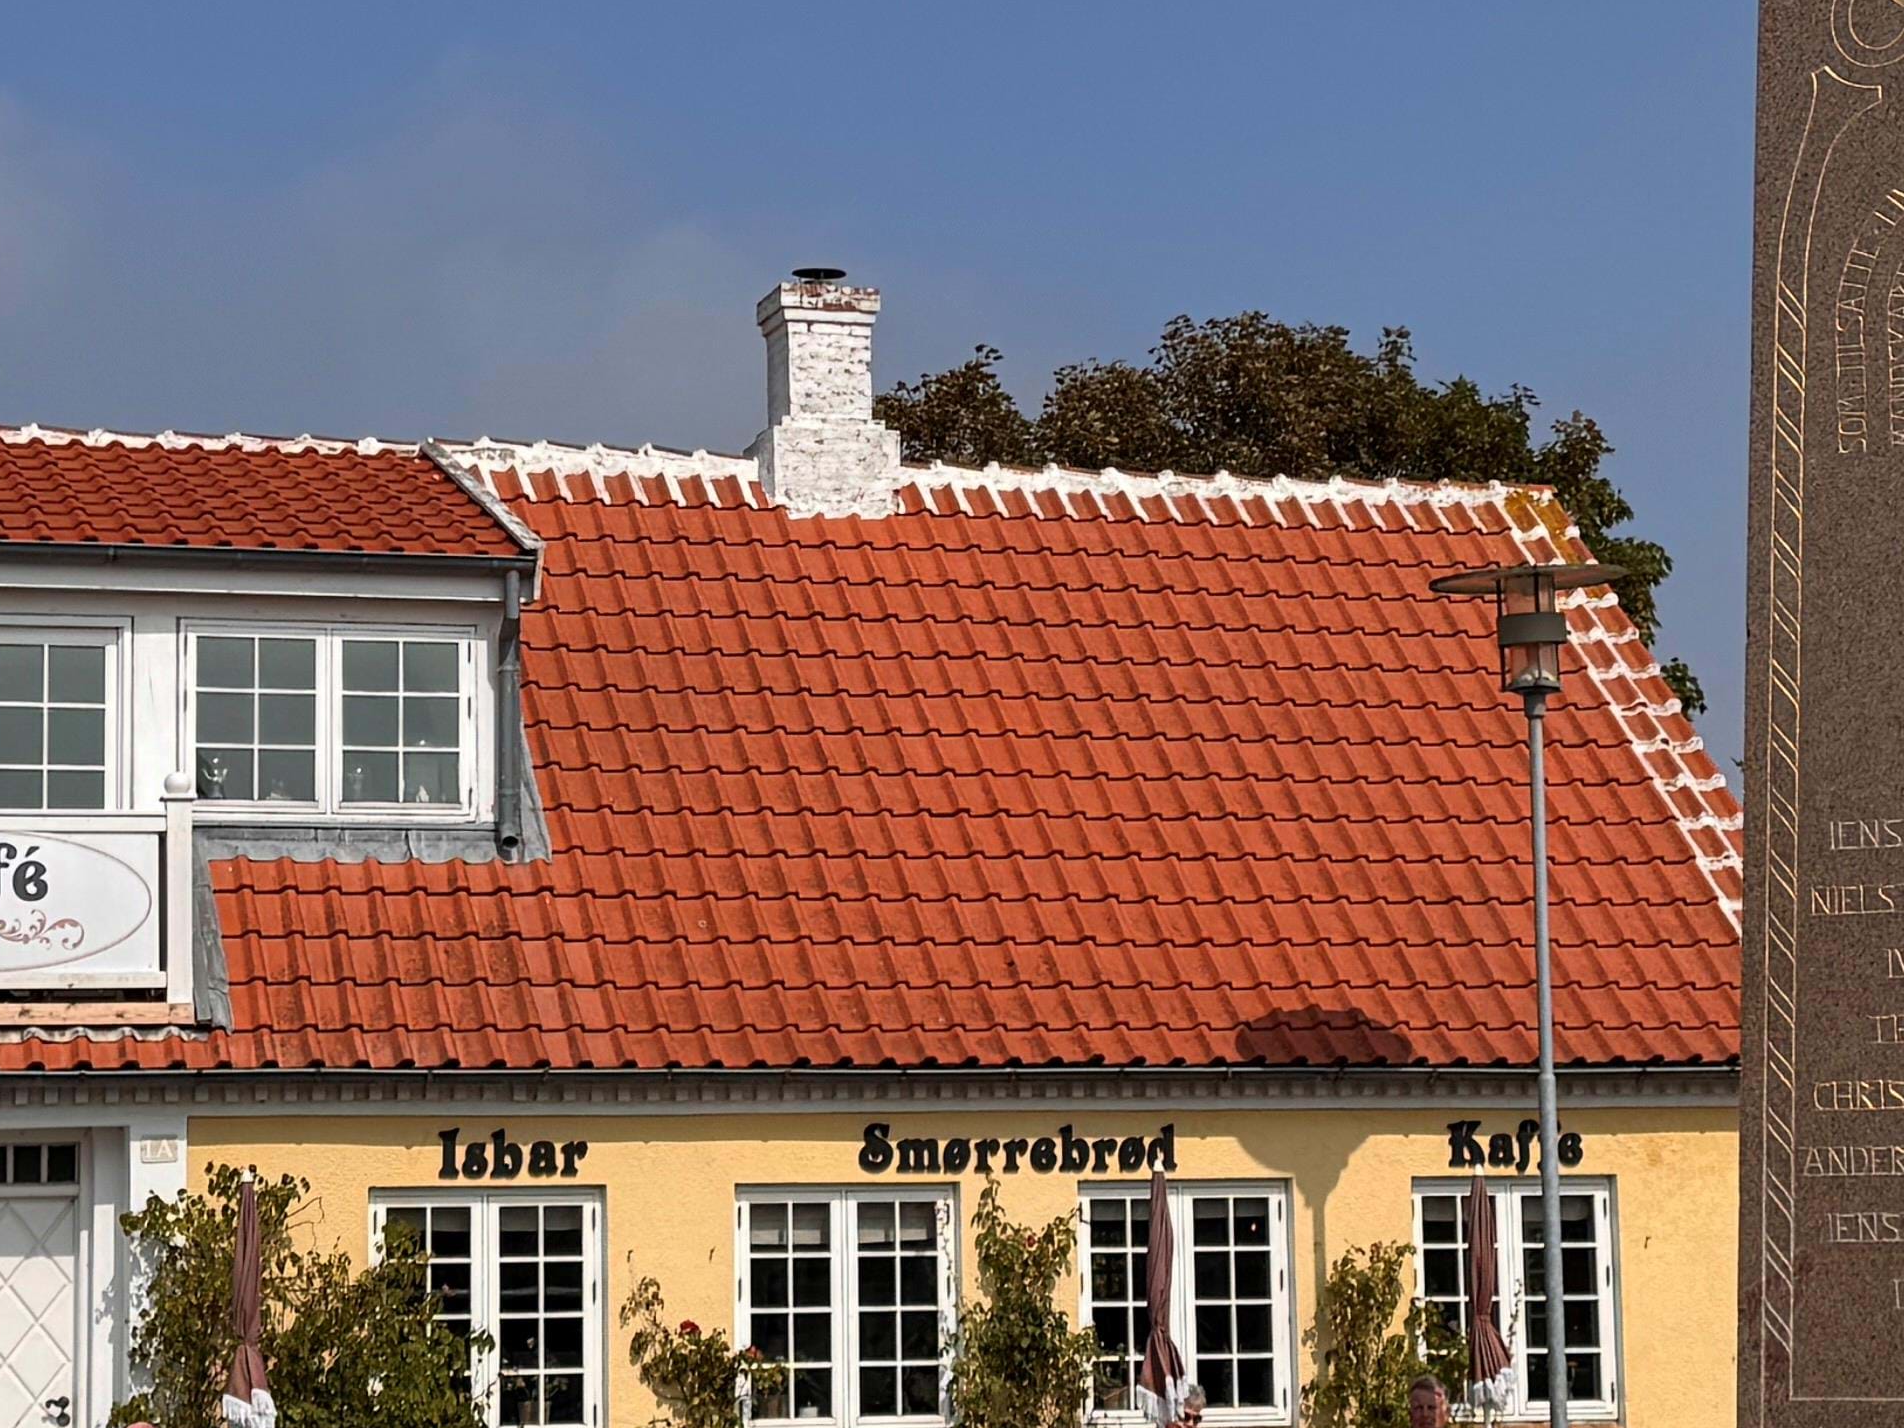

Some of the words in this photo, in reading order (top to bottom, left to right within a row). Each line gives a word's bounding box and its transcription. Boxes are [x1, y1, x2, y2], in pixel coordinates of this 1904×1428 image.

[1837, 396, 1867, 453] SOM
[1811, 884, 1895, 916] NIELS
[144, 1139, 173, 1158] 1A
[438, 1126, 588, 1180] Isbar
[858, 1122, 1177, 1173] Smørrebrød
[1447, 1119, 1584, 1176] Kafe
